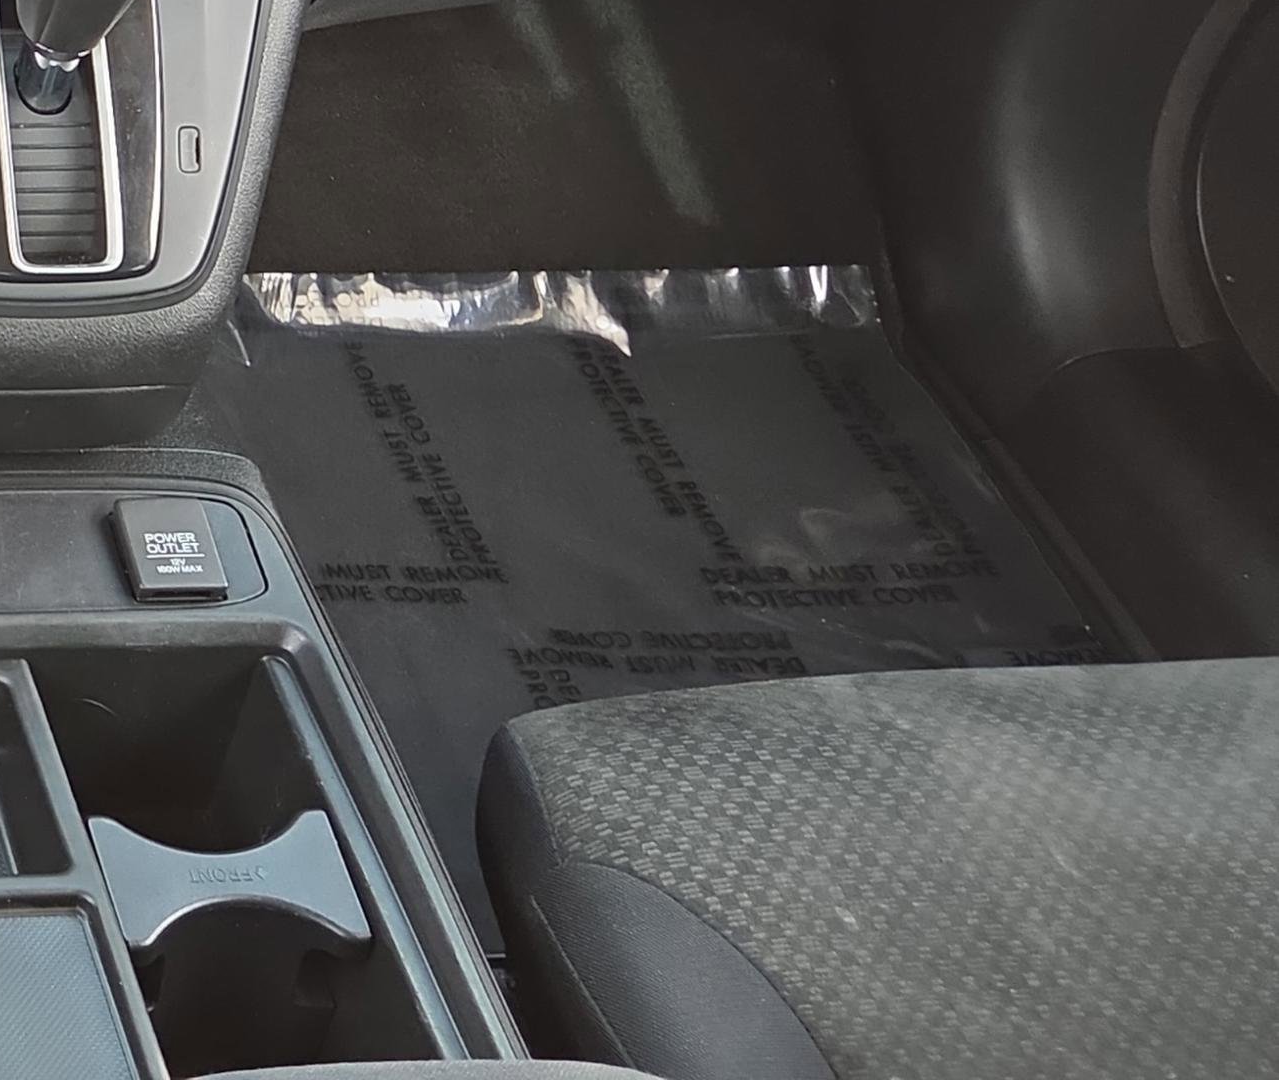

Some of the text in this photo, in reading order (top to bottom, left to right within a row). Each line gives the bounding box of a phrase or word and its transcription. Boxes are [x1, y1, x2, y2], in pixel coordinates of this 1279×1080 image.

[143, 532, 196, 543] POWER
[146, 543, 200, 553] OUTLET
[181, 565, 203, 573] MAX
[320, 563, 510, 584] MUST REMOVE
[699, 566, 793, 584] DEALER
[808, 564, 879, 583] MUST
[384, 586, 468, 604] COVER
[714, 584, 960, 608] PROTECTIVE COVER
[188, 868, 253, 884] FRONT
